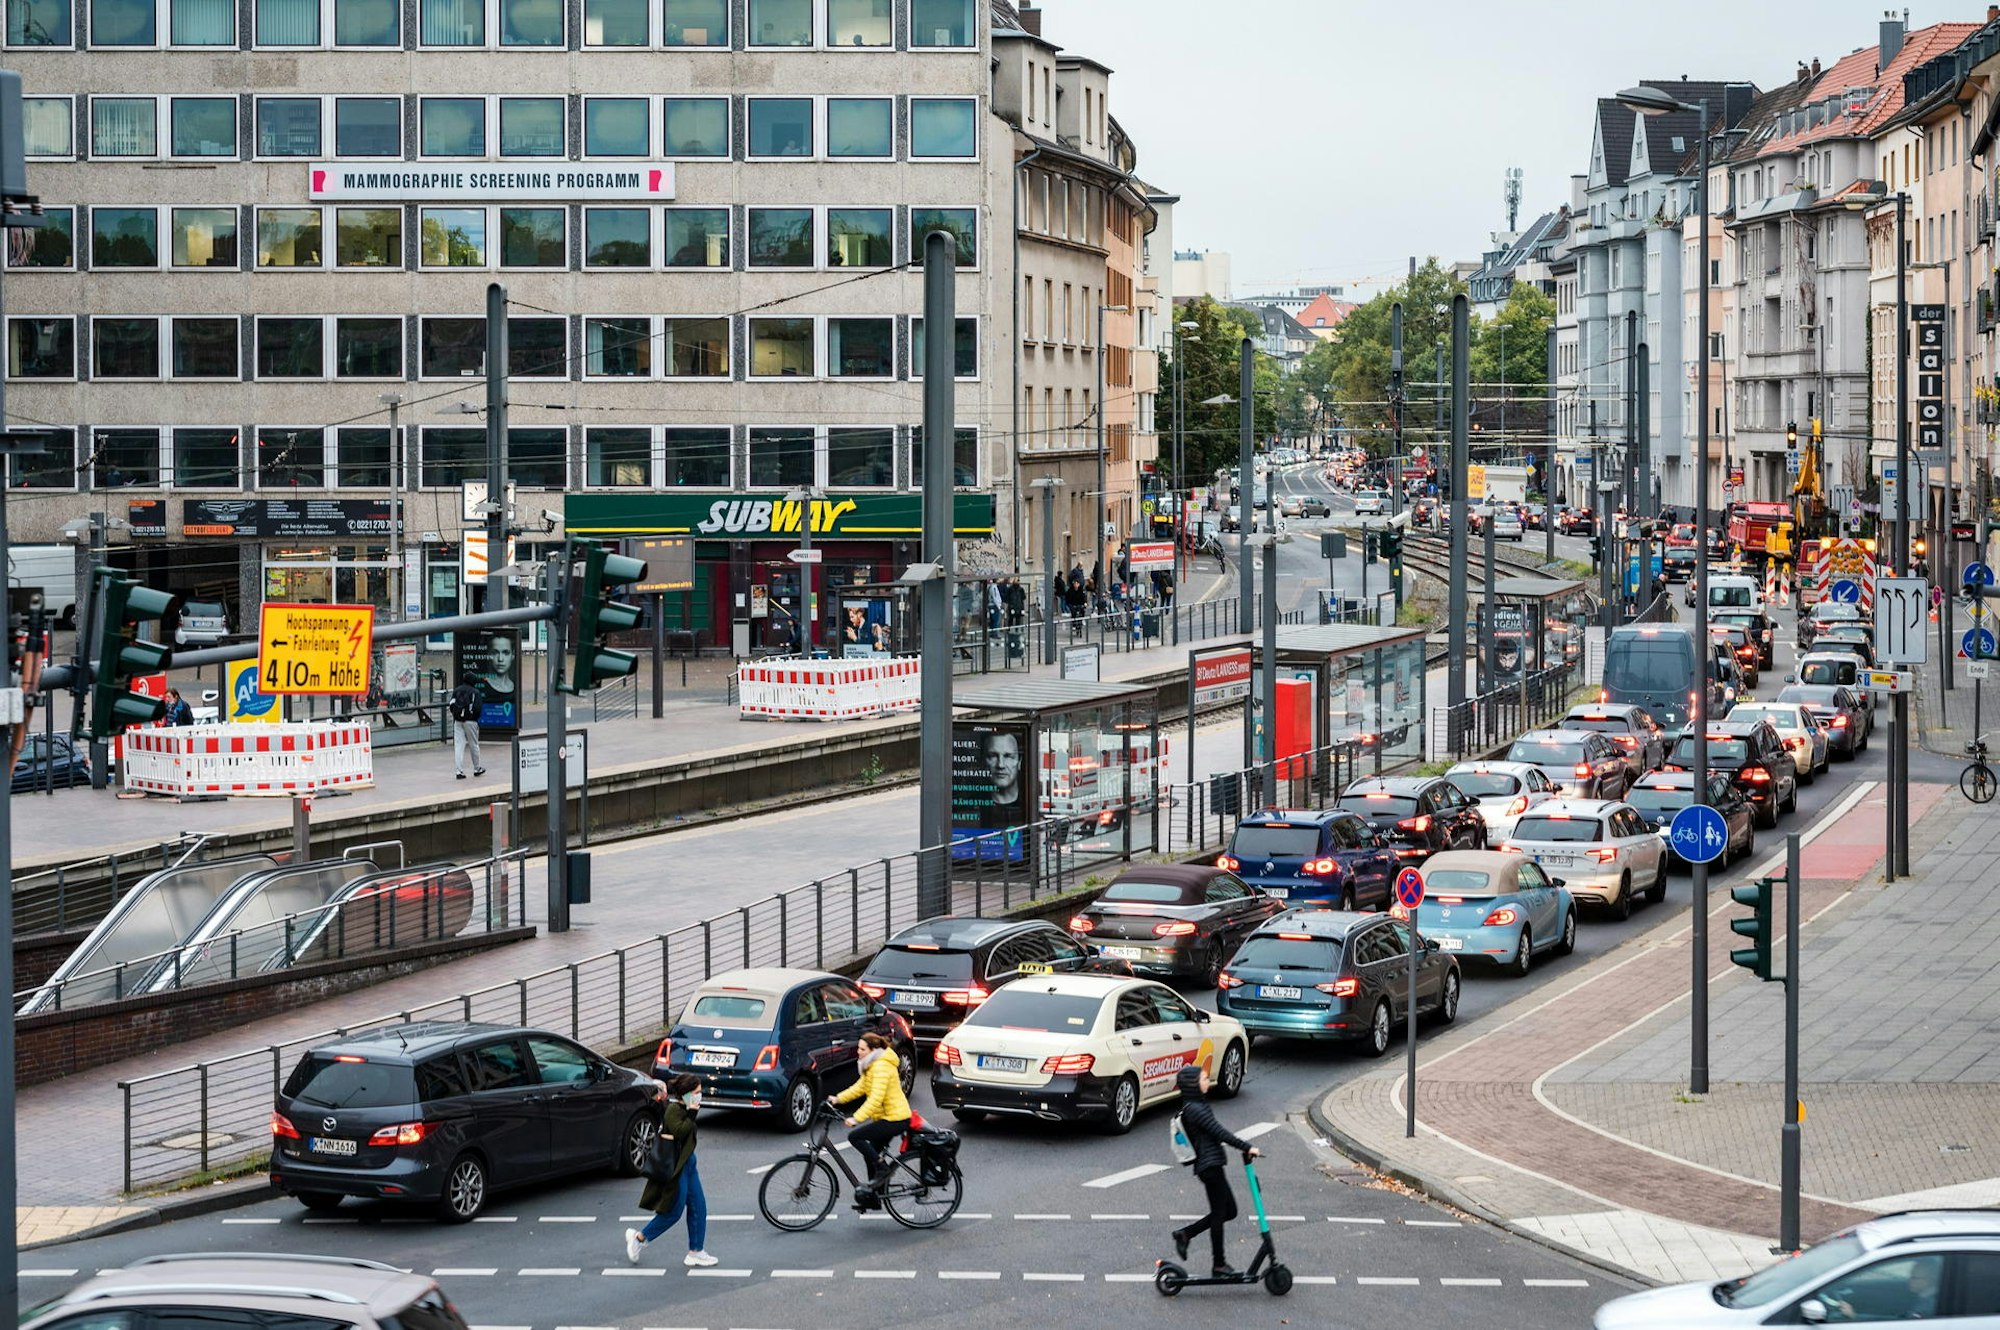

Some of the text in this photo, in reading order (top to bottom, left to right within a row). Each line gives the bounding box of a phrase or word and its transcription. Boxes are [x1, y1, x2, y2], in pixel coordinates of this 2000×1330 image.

[343, 173, 640, 189] MAMMOGRAPHIE SCREENING PROGRAMM
[1919, 308, 1941, 318] der
[1922, 328, 1938, 444] salon
[697, 498, 857, 534] SUBWAY
[287, 614, 349, 634] Hochspannung
[294, 634, 340, 654] Fahrleitung
[330, 661, 360, 686] Höhe
[916, 996, 934, 1004] 1992
[1008, 1060, 1022, 1069] 308
